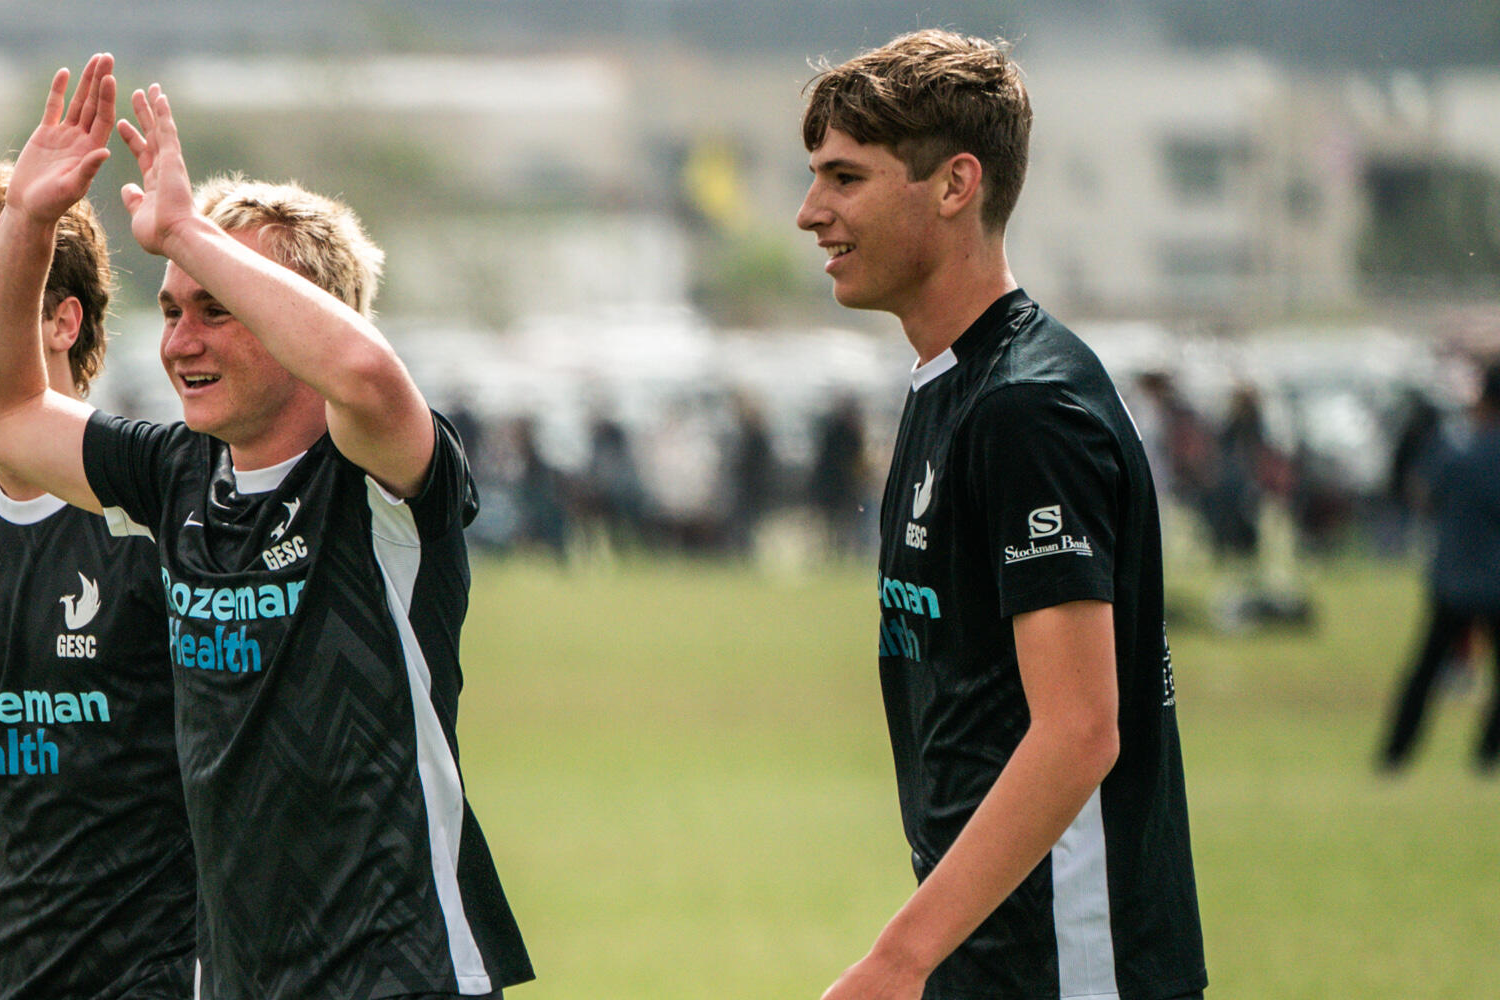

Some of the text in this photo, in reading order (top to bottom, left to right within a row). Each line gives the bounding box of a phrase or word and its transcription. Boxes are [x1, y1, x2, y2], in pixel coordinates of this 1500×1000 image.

[905, 521, 928, 551] GESC
[1005, 535, 1092, 560] Stockman Bank
[261, 535, 308, 571] GESC
[56, 634, 97, 660] GESC
[168, 616, 262, 673] Health
